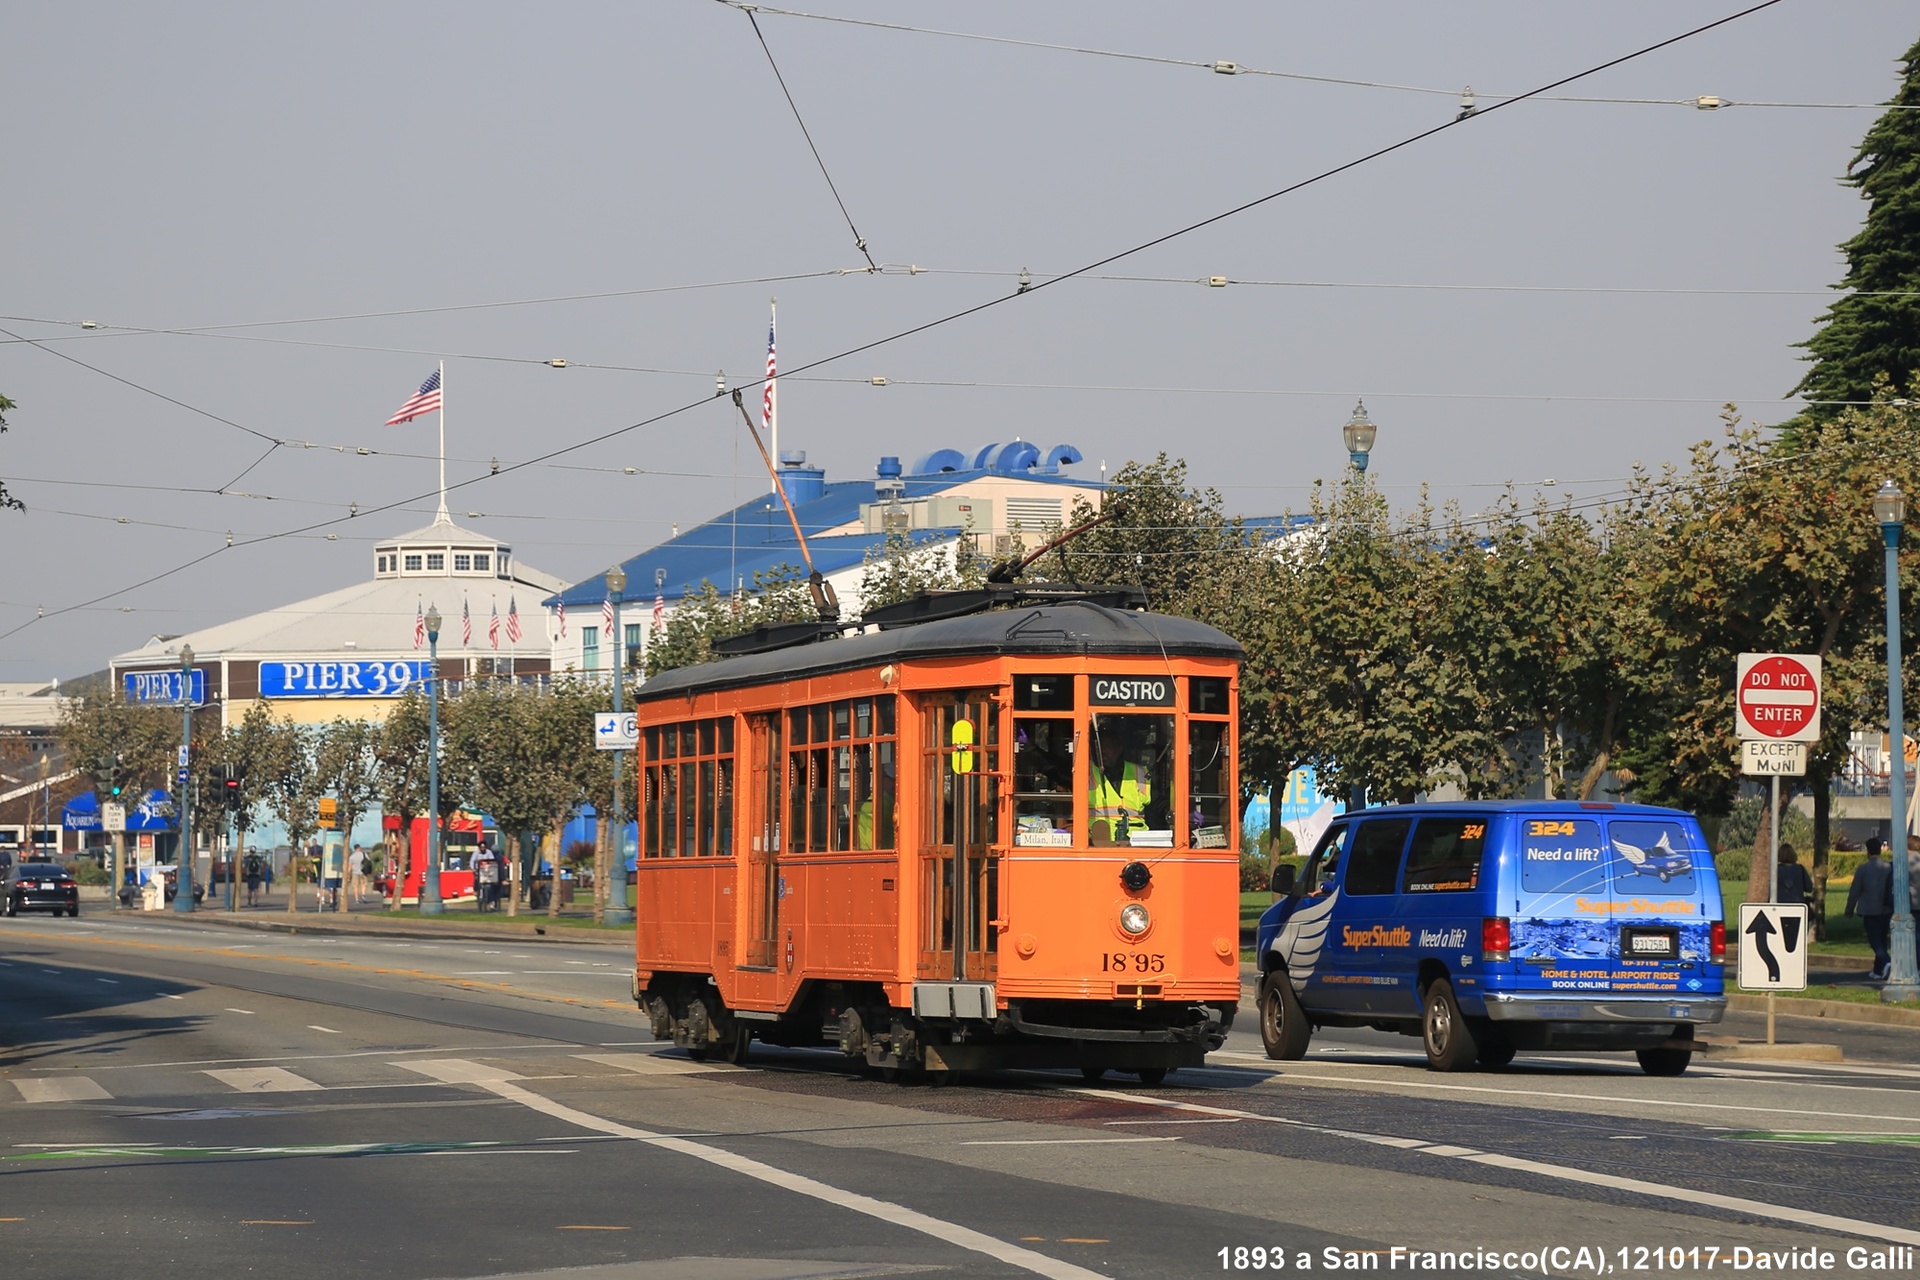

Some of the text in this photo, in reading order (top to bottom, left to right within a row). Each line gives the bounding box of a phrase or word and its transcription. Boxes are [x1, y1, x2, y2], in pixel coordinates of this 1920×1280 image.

[283, 662, 411, 694] PIER 39
[1751, 672, 1807, 687] DO NOT
[135, 673, 172, 700] PIER
[1095, 680, 1166, 701] CASTRO
[1754, 707, 1802, 722] ENTER
[1750, 743, 1801, 757] EXCEPT
[1756, 759, 1796, 773] MUNI
[1460, 824, 1485, 839] 324
[1529, 821, 1576, 836] 324
[1024, 834, 1067, 845] Milan, Italy
[1527, 847, 1600, 861] Need a lift?
[1575, 897, 1696, 916] SuperShuttle
[1342, 925, 1467, 952] SuperShuttle Need a lift?
[1102, 952, 1166, 973] 1895
[1541, 970, 1680, 980] HOME & HOTEL AIRPORT RIDES
[1552, 981, 1677, 992] BOOK ONLINE supershuttle.com
